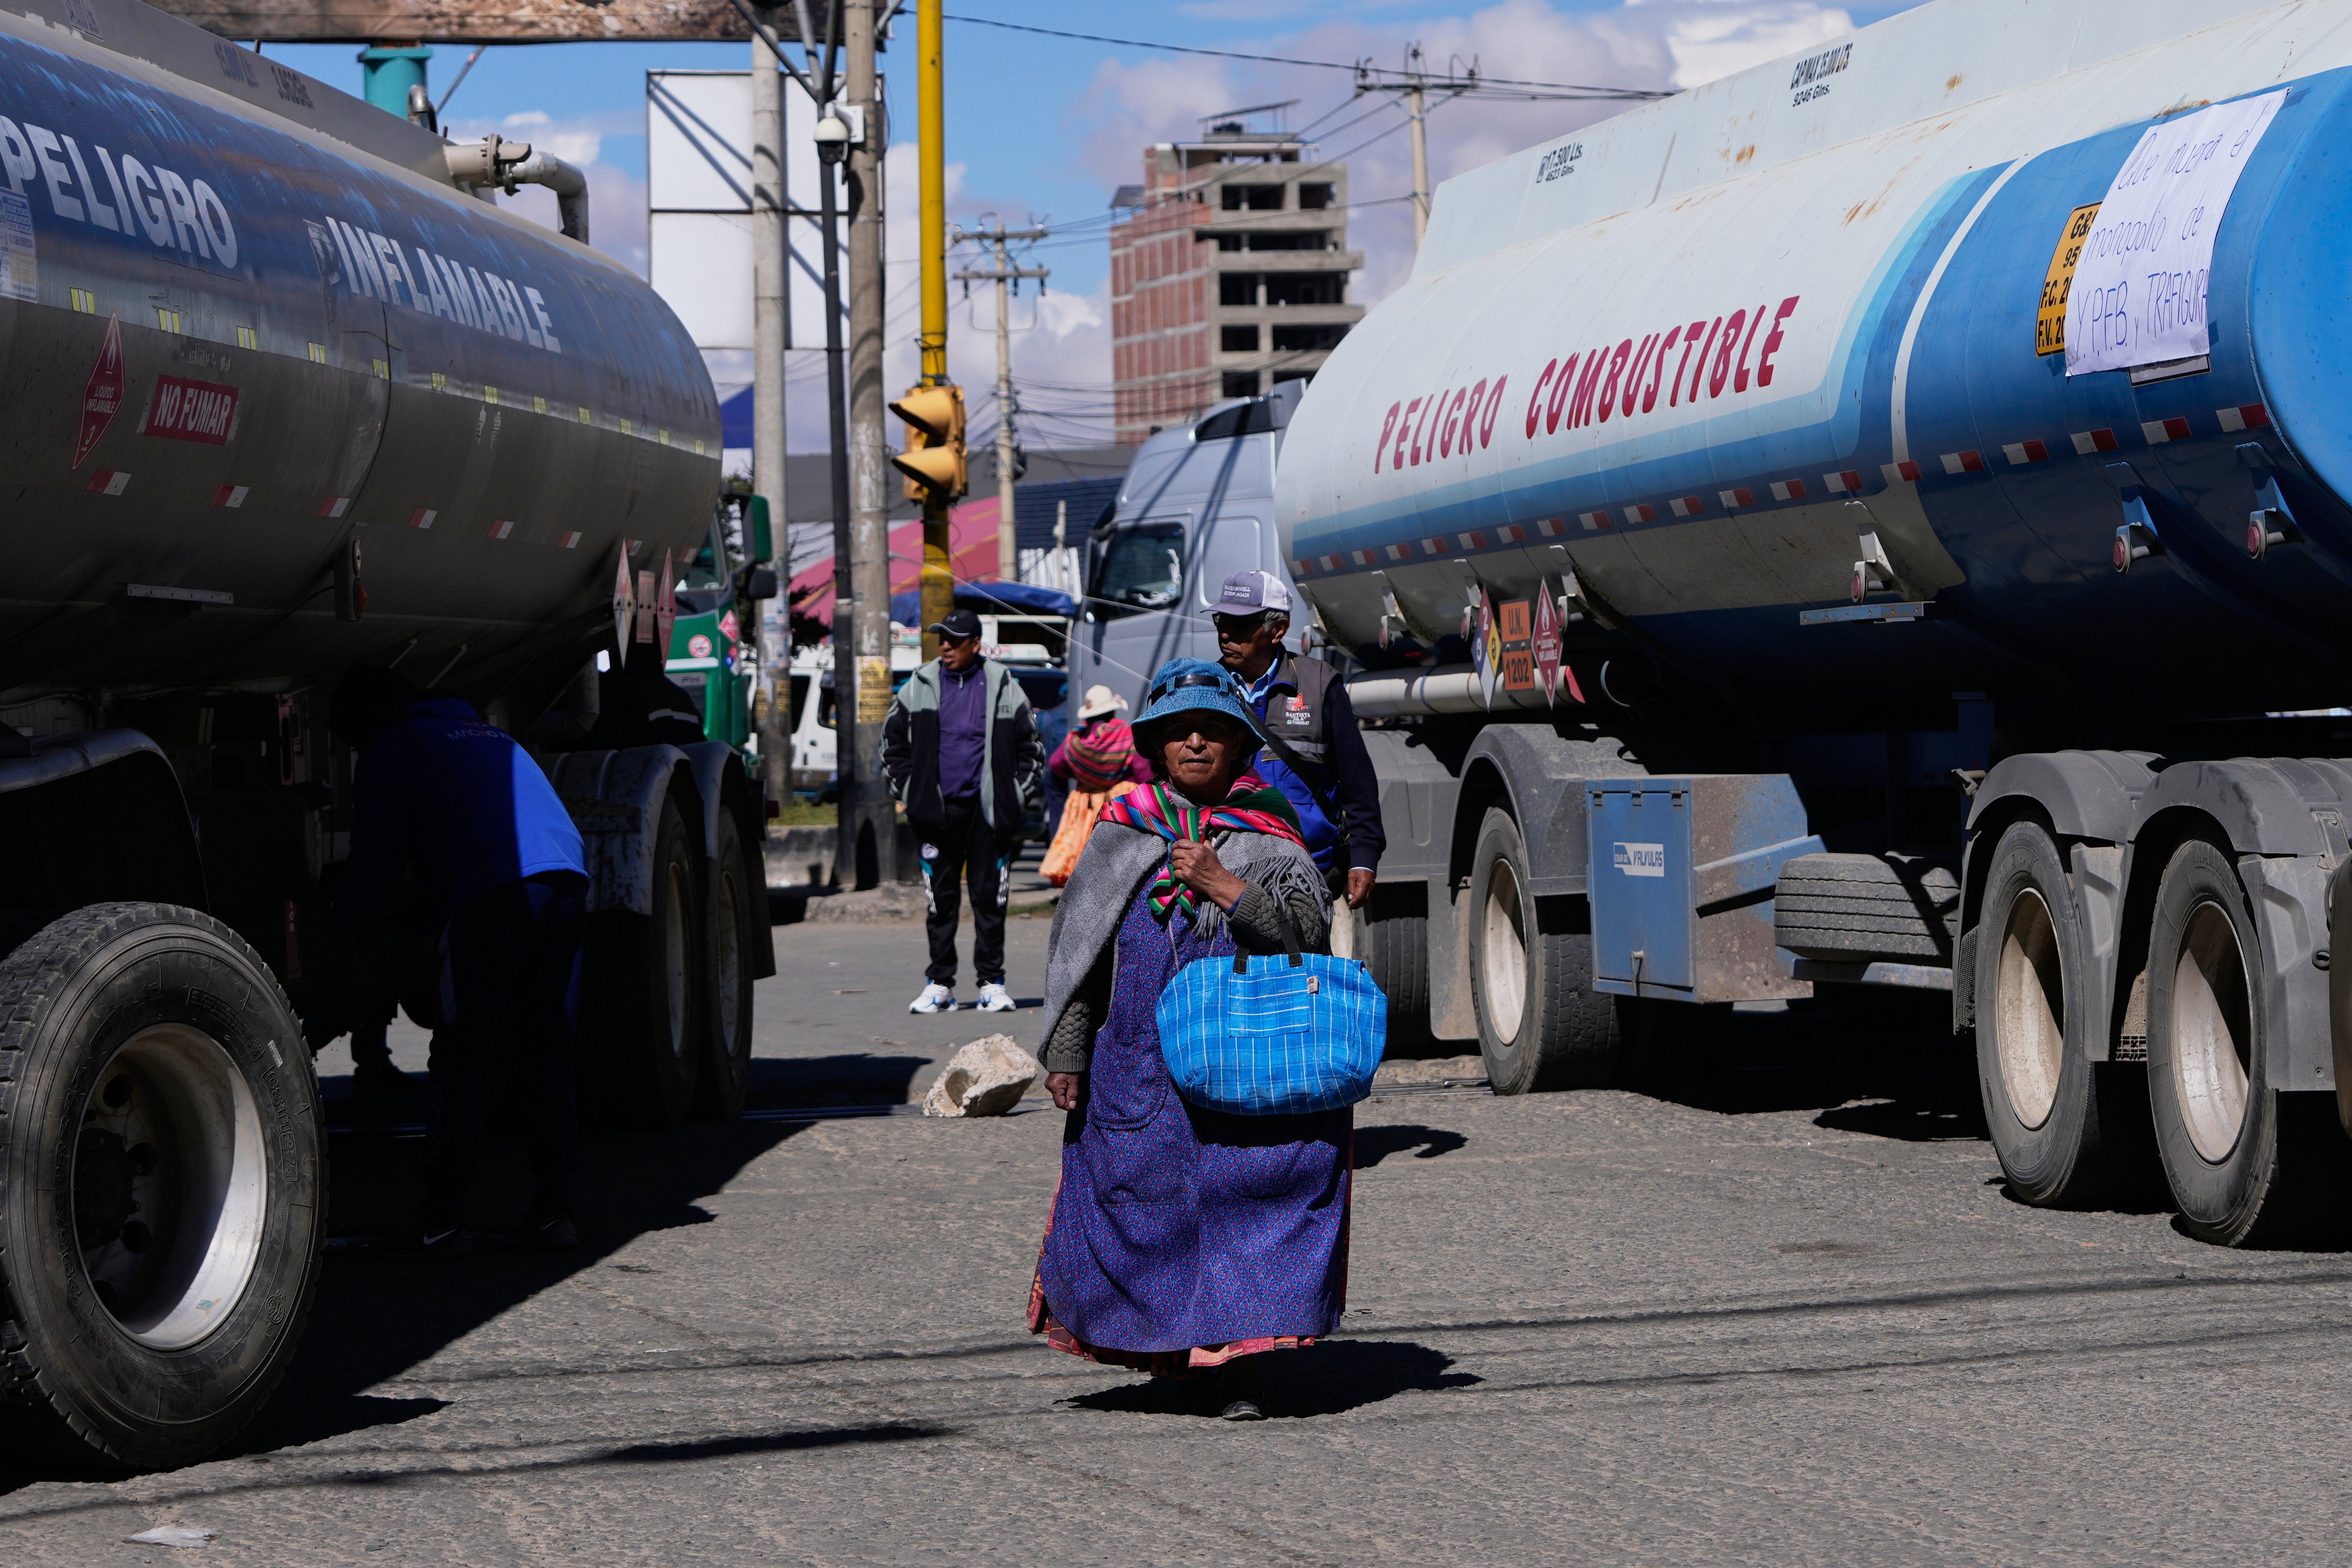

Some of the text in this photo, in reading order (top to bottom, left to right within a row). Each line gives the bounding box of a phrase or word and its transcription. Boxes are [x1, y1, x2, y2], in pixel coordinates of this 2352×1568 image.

[1792, 87, 1813, 107] 9246
[1545, 144, 1571, 171] 17.500
[2118, 100, 2270, 190] Que muera el
[0, 114, 238, 268] PELIGRO
[325, 216, 561, 354] INFLAMABLE
[2084, 190, 2206, 266] monopolio de
[2063, 245, 2082, 268] 95
[2040, 279, 2058, 309] F.C.
[2147, 268, 2210, 339] TRAFIGURA
[2038, 318, 2052, 348] F.V.
[94, 385, 115, 399] LIQUIDO
[1375, 295, 1800, 474] PELIGRO COMBUSTIBLE
[86, 398, 116, 414] INFLAMABLE
[154, 384, 232, 436] NO FUMAR
[85, 424, 96, 445] 3
[1482, 606, 1489, 631] 2
[1539, 649, 1558, 662] INFLAMABLE
[1506, 657, 1530, 683] 1202
[1547, 668, 1552, 690] 3
[1633, 850, 1663, 867] VALVULAS
